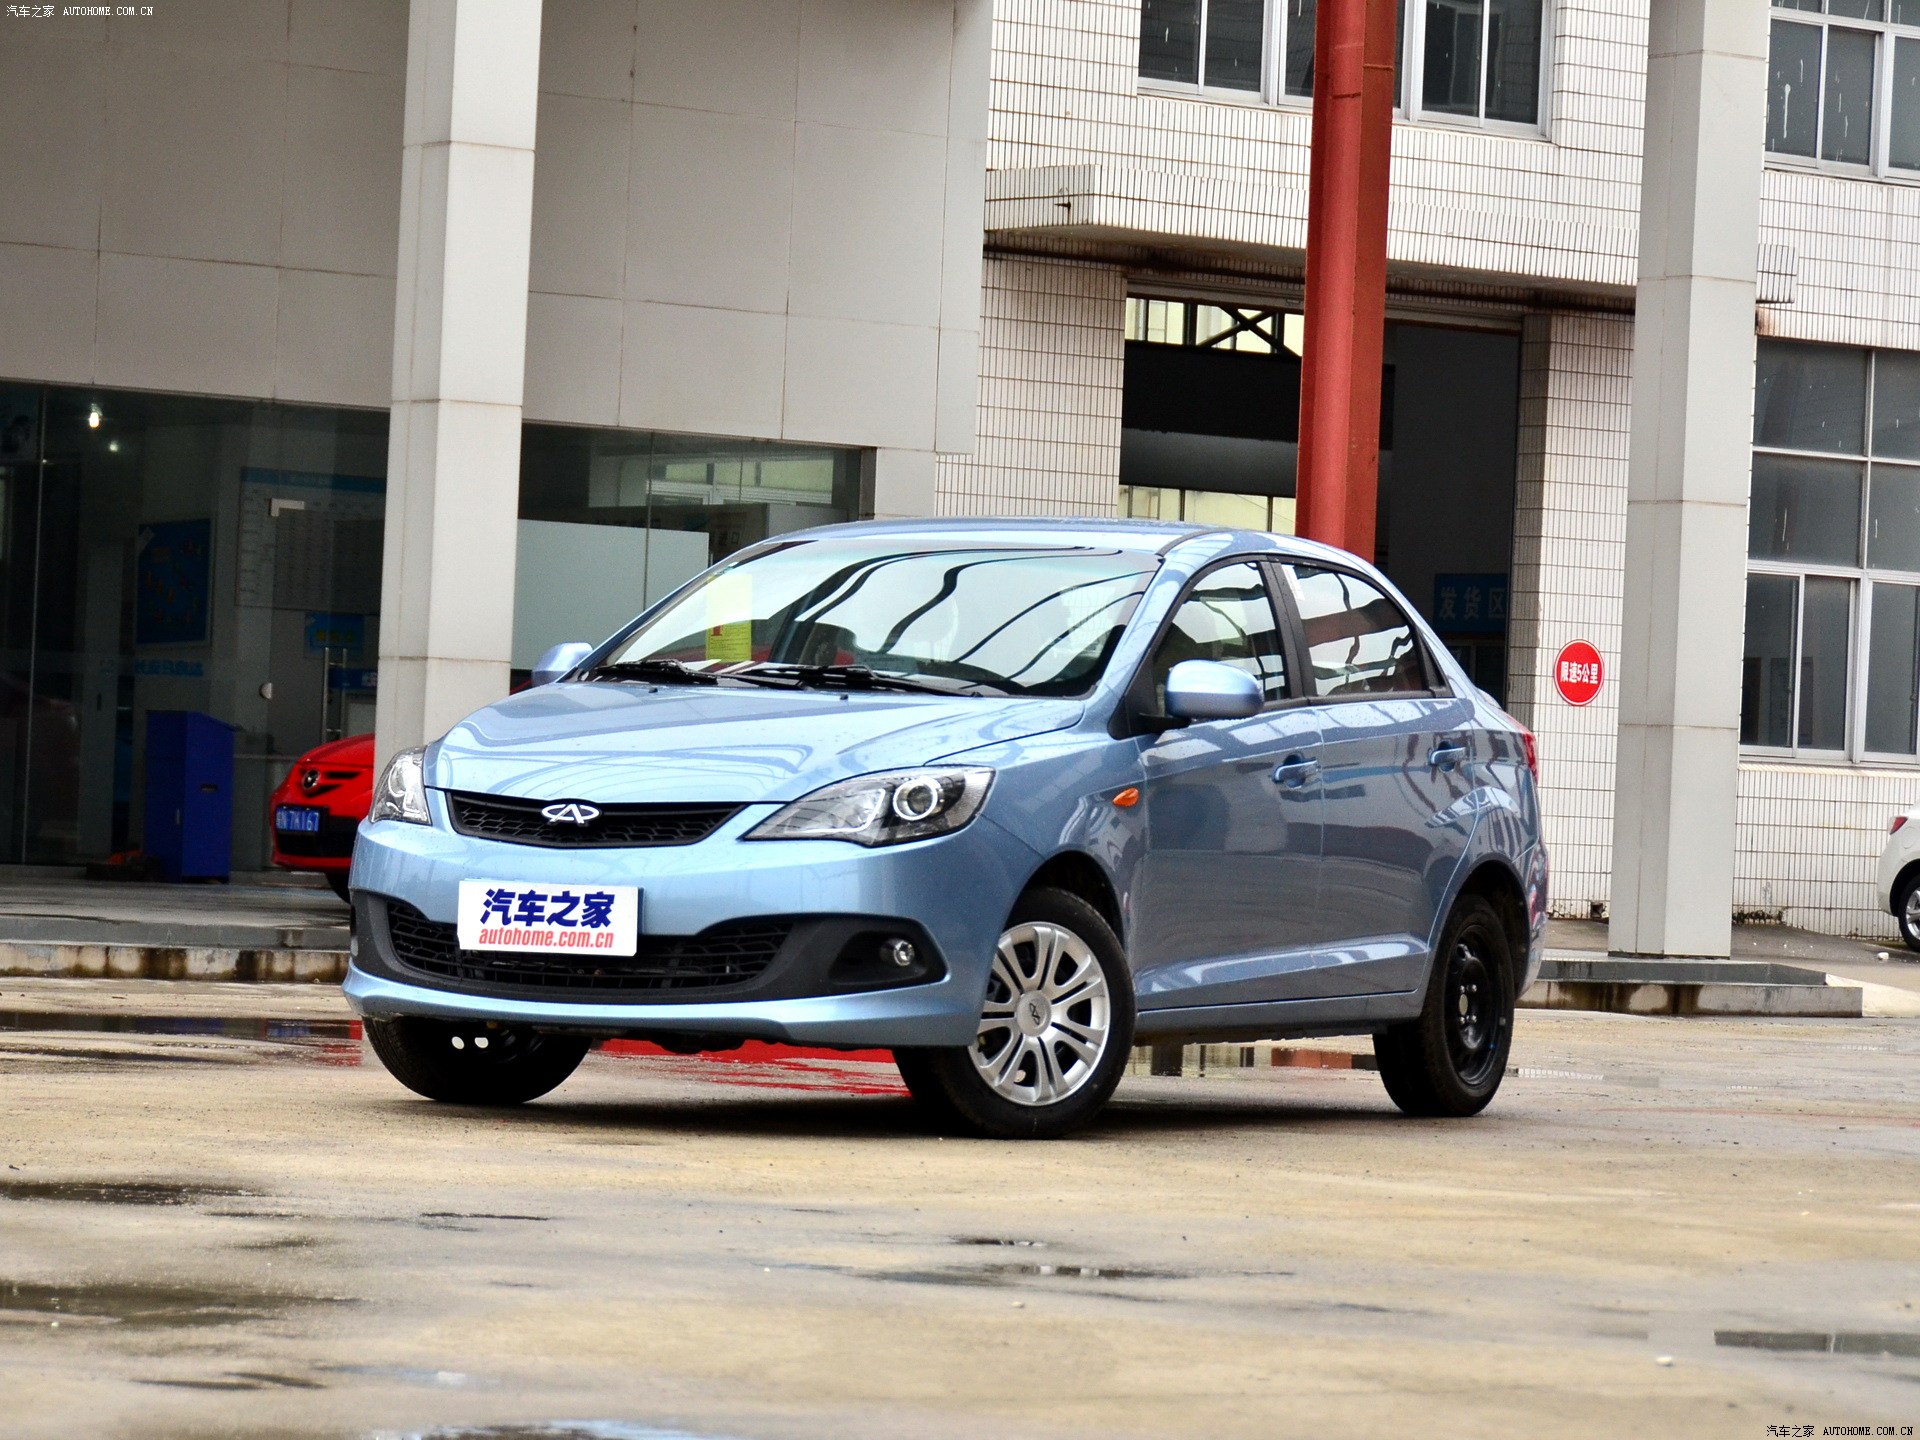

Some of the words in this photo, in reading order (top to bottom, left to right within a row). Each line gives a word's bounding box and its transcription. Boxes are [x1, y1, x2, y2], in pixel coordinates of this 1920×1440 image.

[1438, 584, 1506, 622] 发货区
[1560, 660, 1599, 685] 限速5公里
[479, 888, 616, 929] 汽车之家
[478, 926, 614, 949] autohome.com.cn
